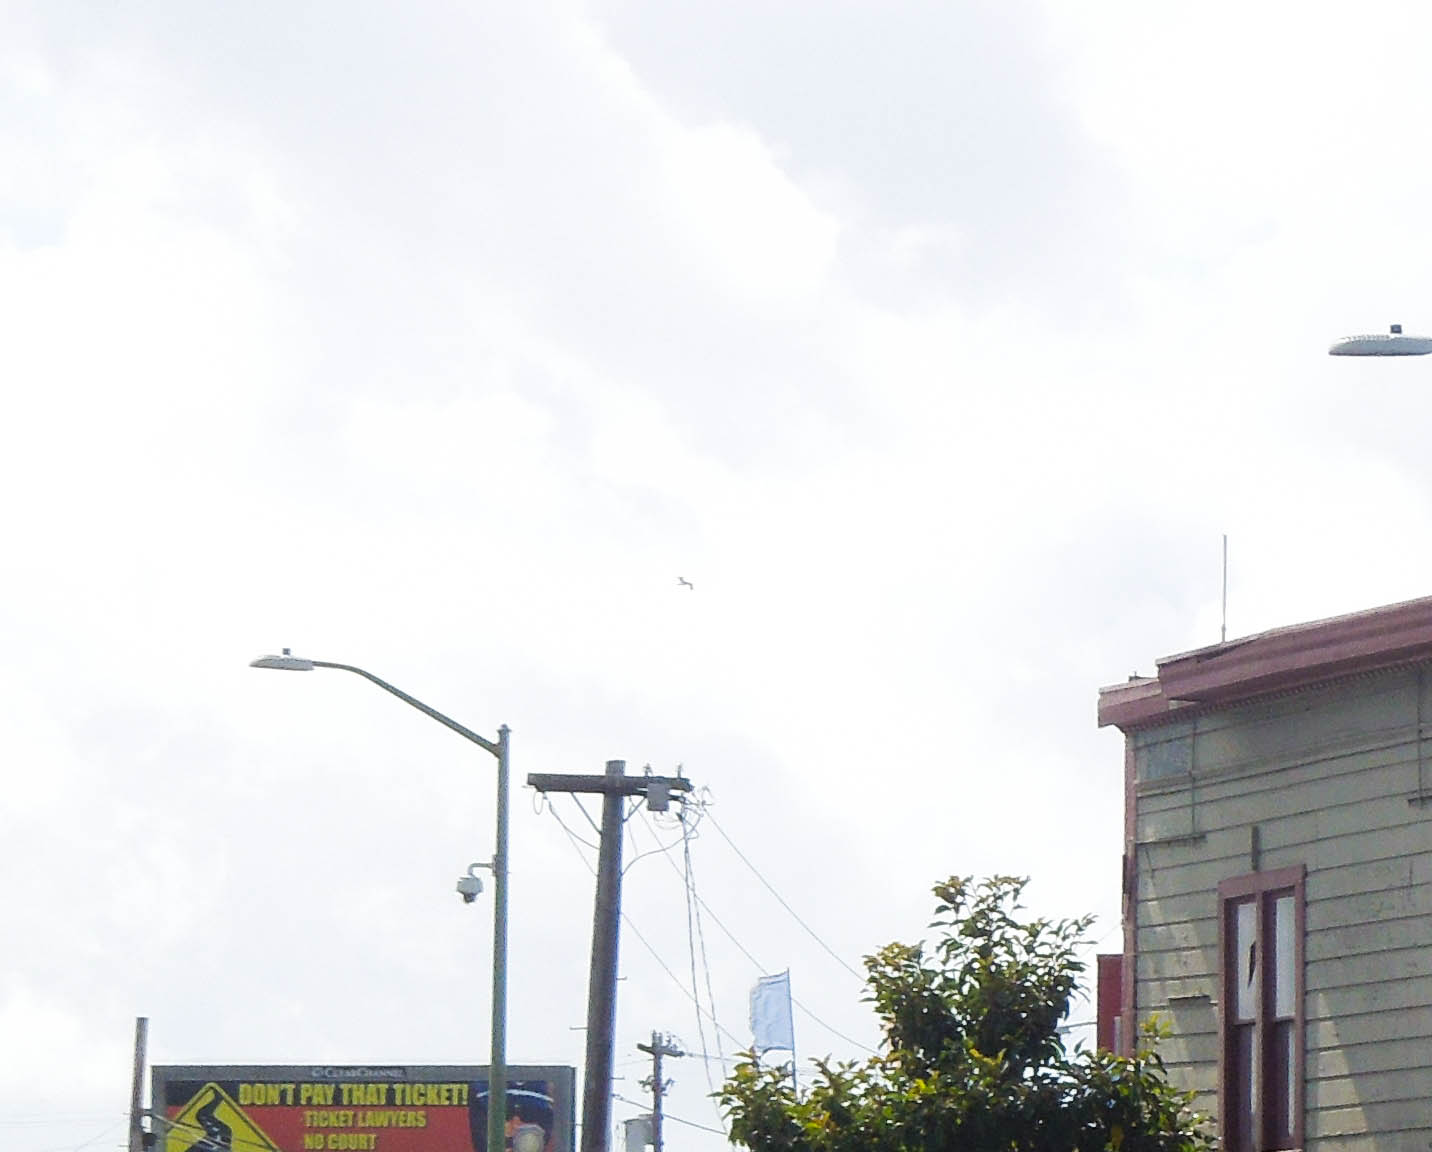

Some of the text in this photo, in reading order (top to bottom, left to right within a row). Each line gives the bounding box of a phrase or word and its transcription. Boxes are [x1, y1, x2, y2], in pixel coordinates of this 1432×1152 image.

[239, 1083, 469, 1106] DON'T PAY THAT TICKET!
[303, 1110, 427, 1128] TICKET LAWYERS
[303, 1133, 377, 1150] NO COURT
